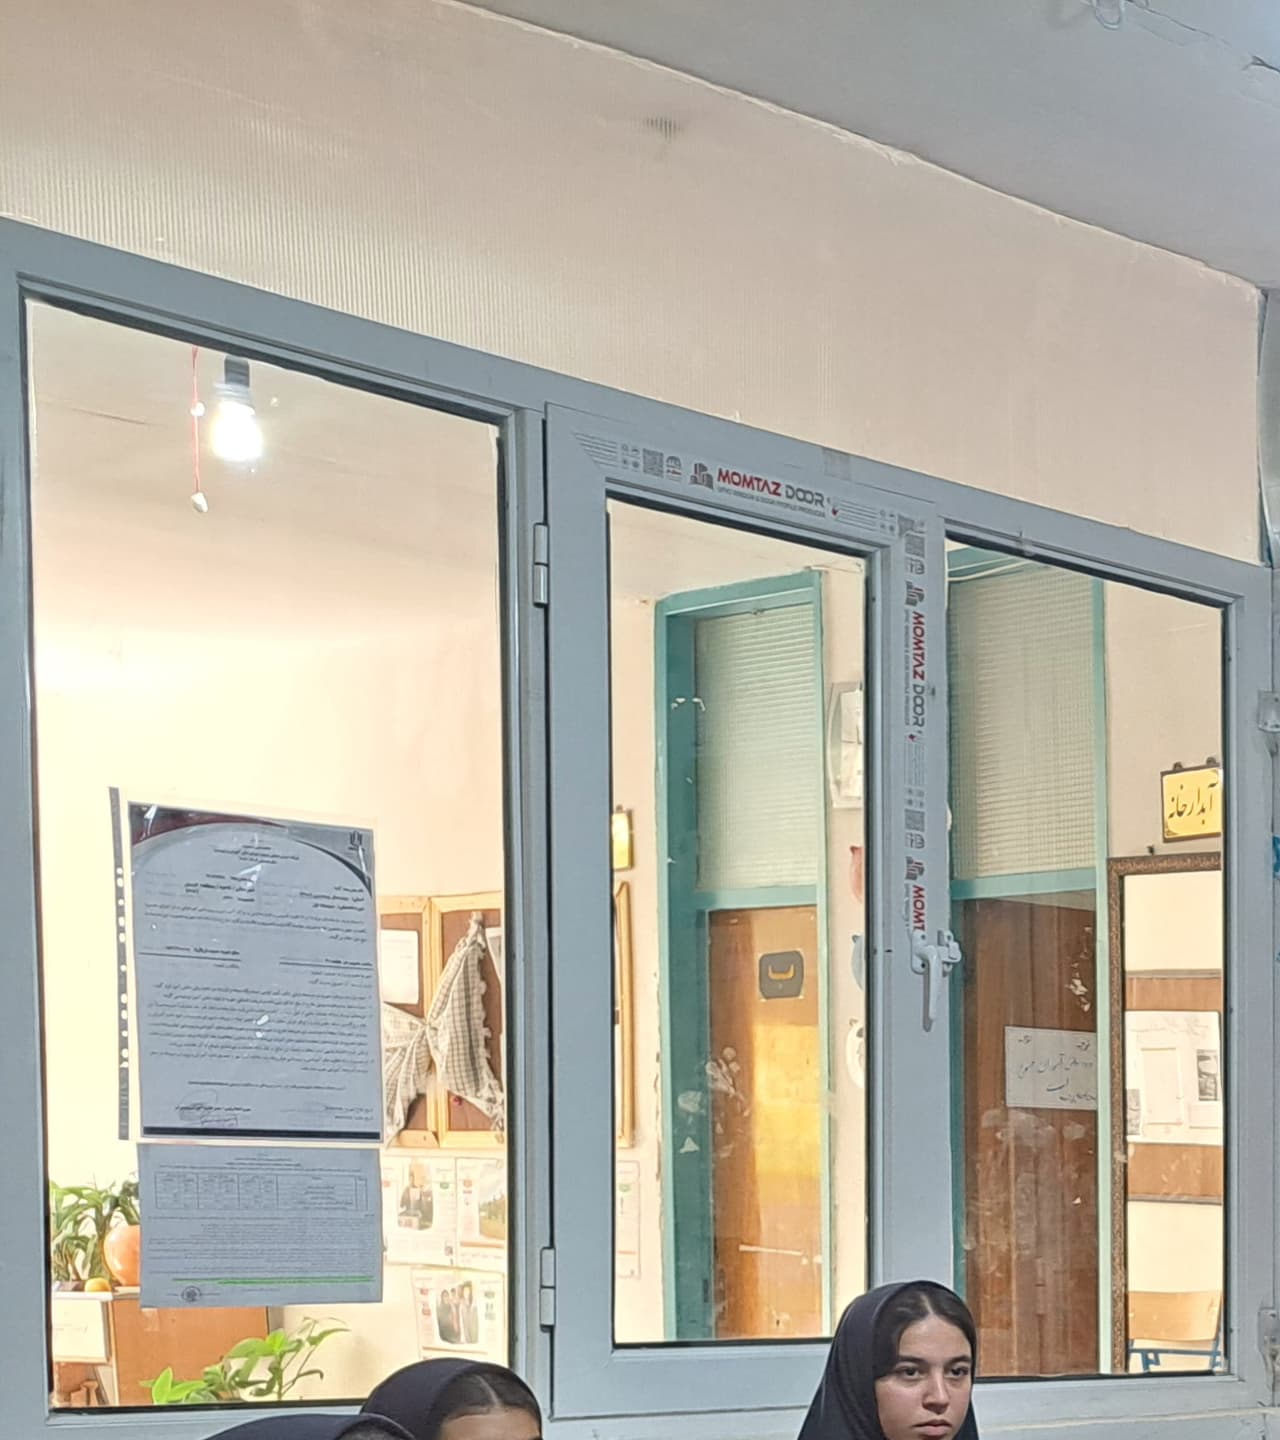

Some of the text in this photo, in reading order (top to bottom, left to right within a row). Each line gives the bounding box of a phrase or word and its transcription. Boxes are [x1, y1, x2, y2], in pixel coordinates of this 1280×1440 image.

[717, 468, 825, 507] MOMTAZ DOOR
[912, 611, 925, 728] MOMTAZ DOOR
[1168, 783, 1217, 825] آبدارخانه
[912, 885, 925, 931] MOMT
